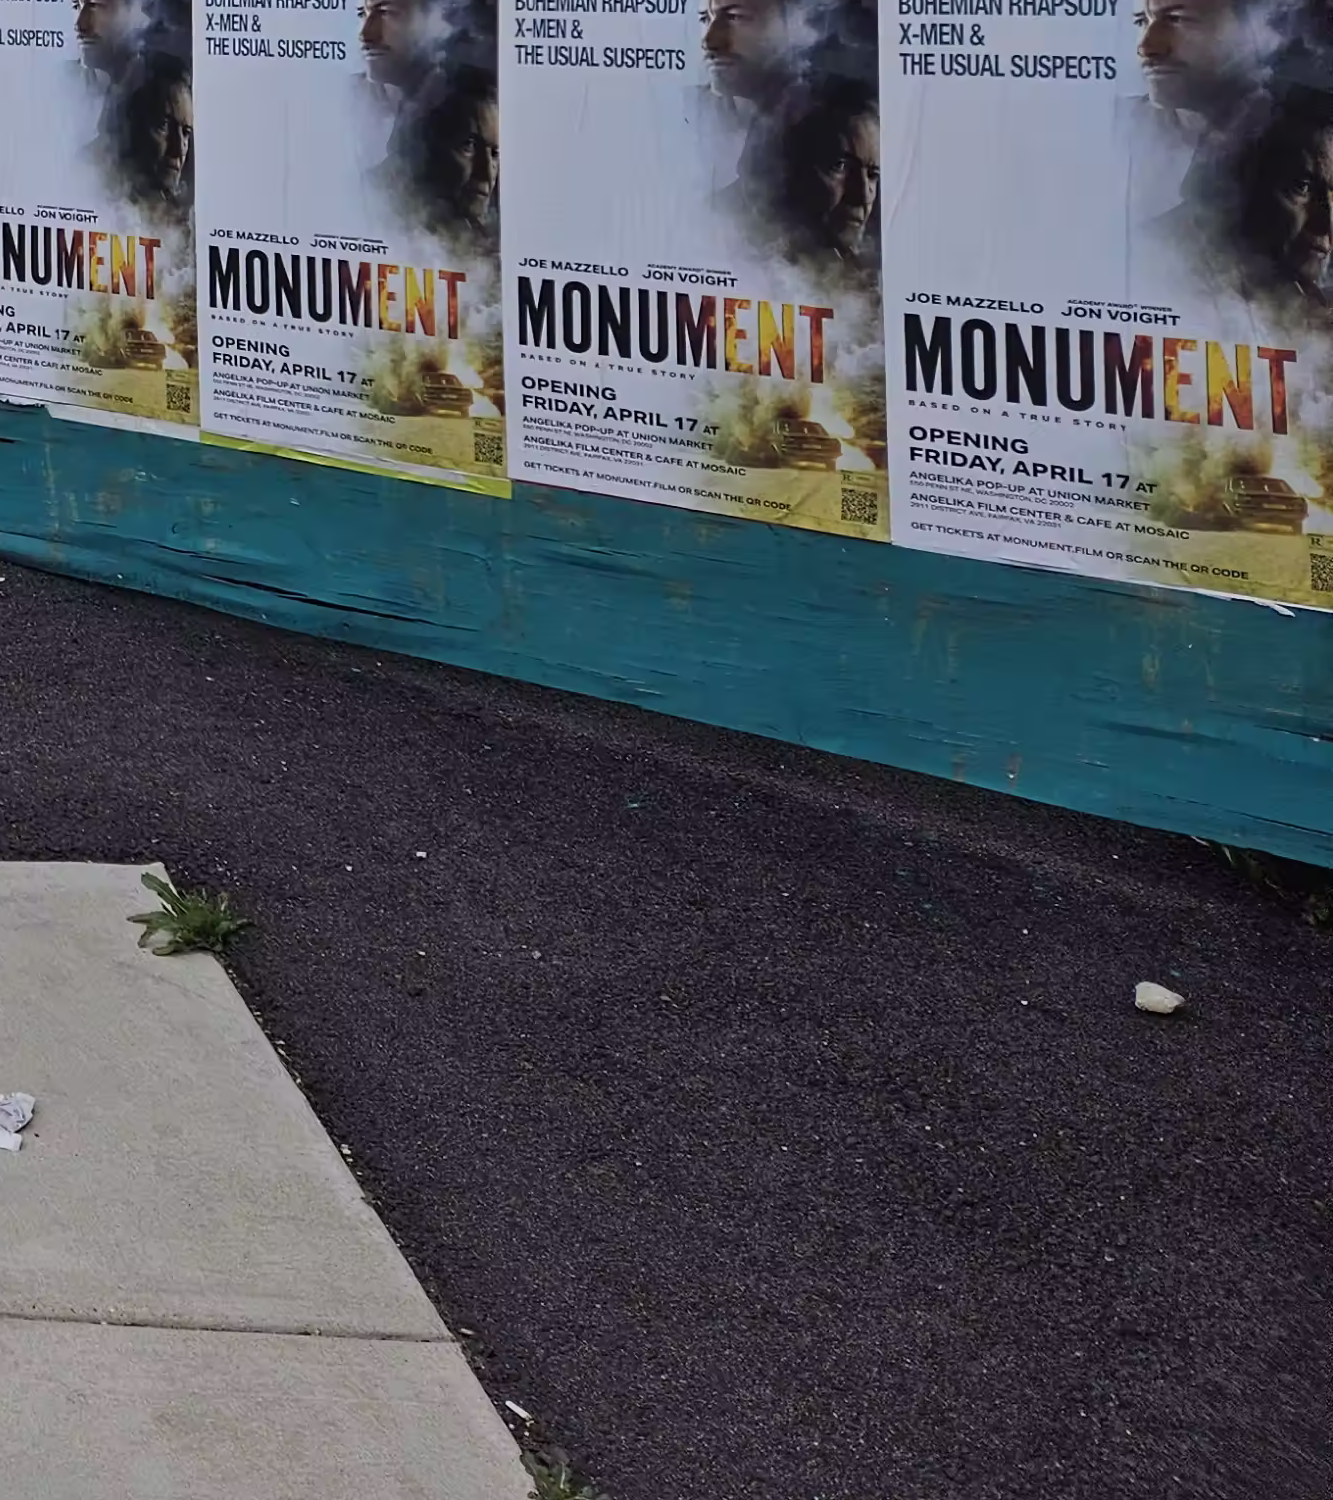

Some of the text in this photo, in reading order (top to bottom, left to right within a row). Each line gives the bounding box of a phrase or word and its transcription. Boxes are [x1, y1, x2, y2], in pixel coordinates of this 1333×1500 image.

[205, 37, 346, 60] THE USUAL SUSPECTS
[899, 22, 985, 46] X-MEN &
[899, 52, 1116, 80] THE USUAL SUSPECTS
[209, 245, 466, 339] MONUMENT
[905, 291, 1180, 327] JOE MAZZELLO JON VOIGHT
[7, 321, 50, 339] APRIL
[54, 329, 70, 342] 17
[73, 335, 85, 345] AT
[212, 335, 290, 357] OPENING
[517, 276, 833, 383] MONUMENT
[212, 352, 374, 388] FRIDAY, APRIL 17 AT
[522, 375, 617, 401] OPENING
[904, 314, 1297, 434] MONUMENT
[522, 394, 719, 437] FRIDAY, APRIL 17 AT
[908, 400, 960, 411] BASED
[971, 407, 991, 415] ON
[1020, 412, 1061, 423] TRUE
[1072, 418, 1127, 432] STORY
[909, 425, 1028, 454] OPENING
[909, 446, 1157, 494] FRIDAY, APRIL 17 AT
[909, 470, 1150, 511] ANGELIKA POP-UP AT UNION MARKET
[909, 492, 1189, 540] ANGELIKA FILM CENTER & CAFE AT MOSAIC
[910, 521, 1249, 580] GET TICKETS AT MONUMENT.FILM OR SCAN THE QR CODE
